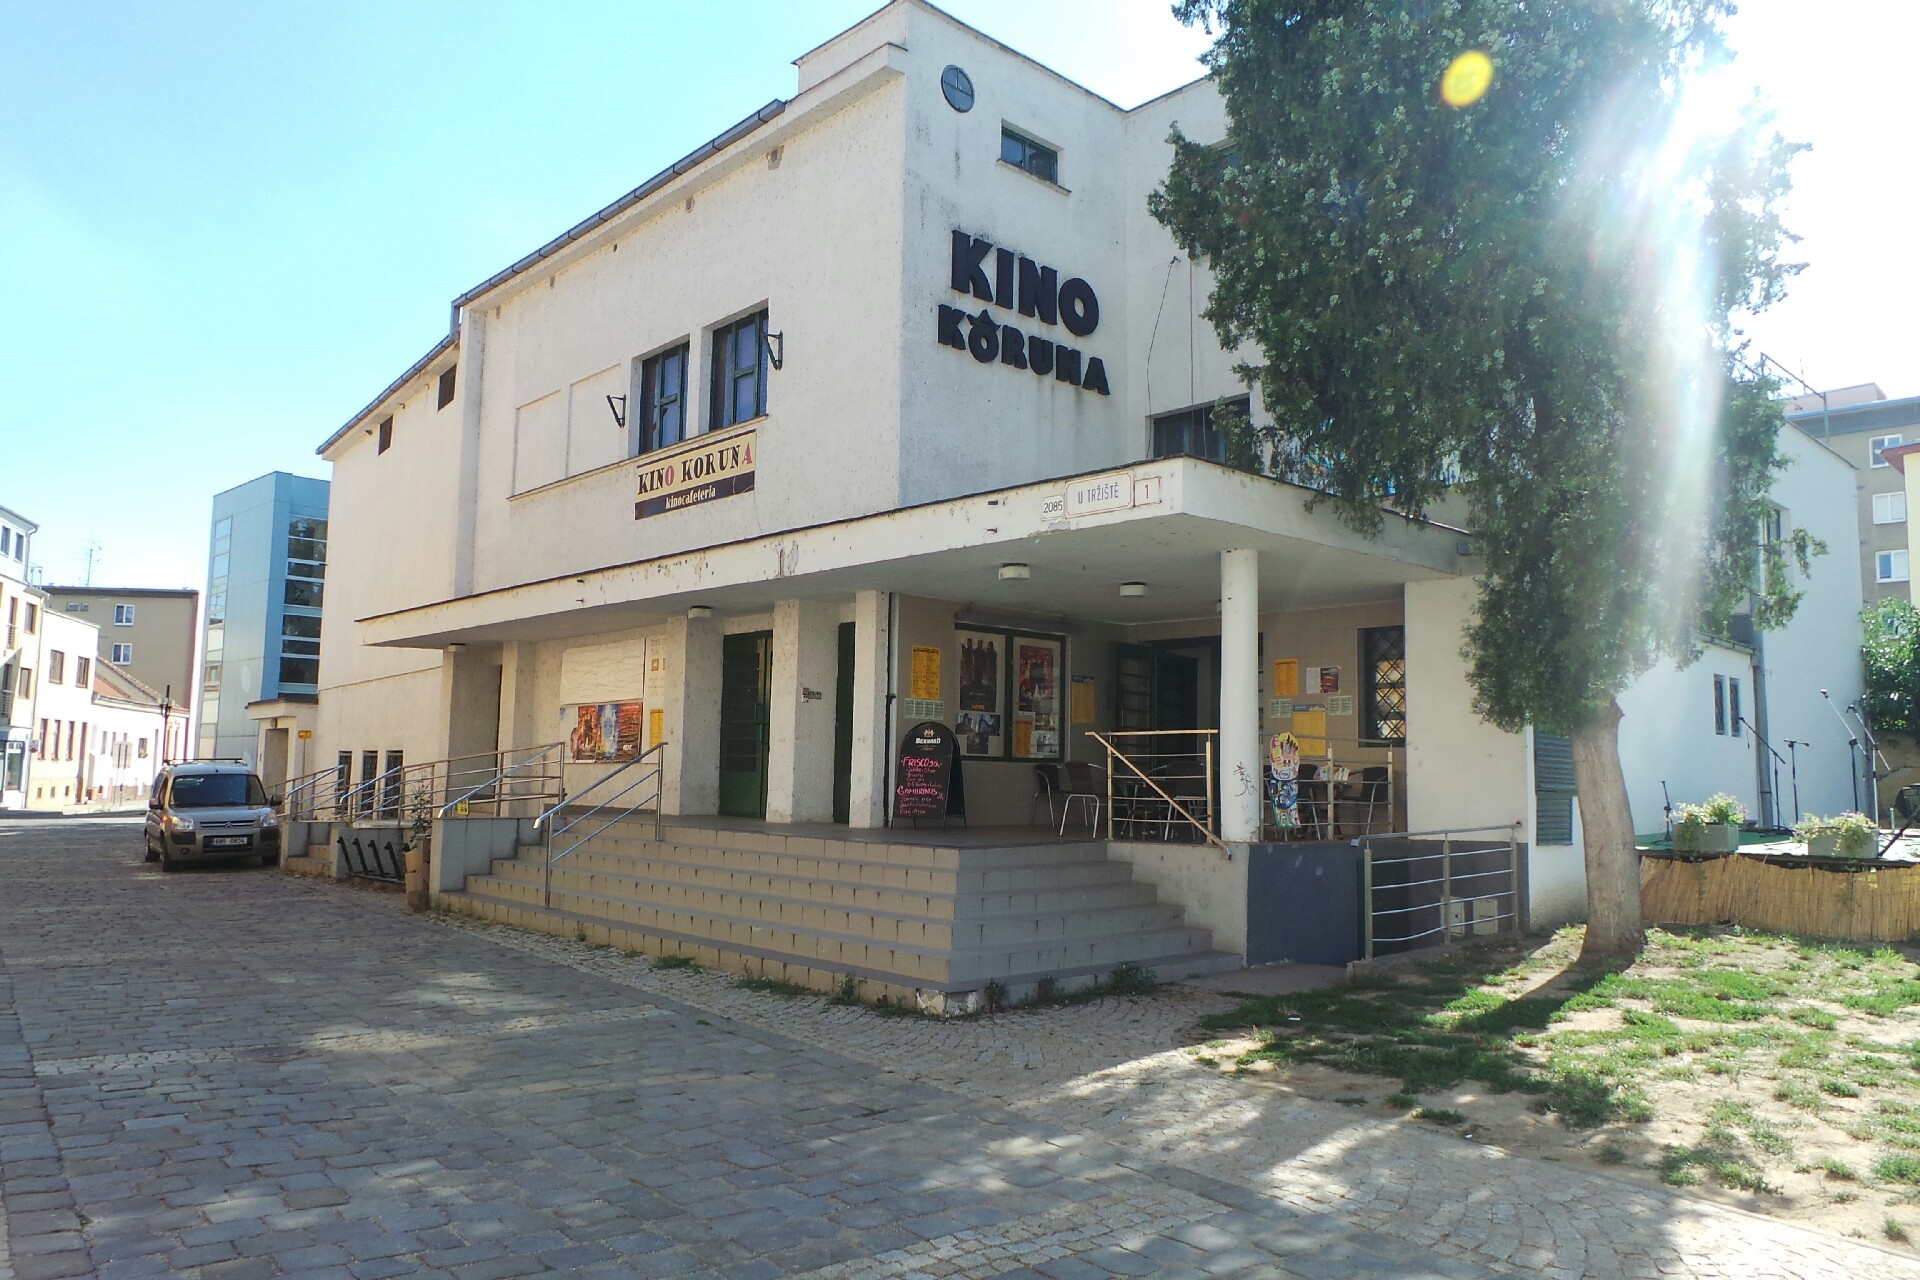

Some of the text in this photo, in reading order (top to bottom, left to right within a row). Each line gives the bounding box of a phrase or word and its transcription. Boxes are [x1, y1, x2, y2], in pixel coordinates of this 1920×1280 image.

[950, 229, 1100, 337] KINO
[937, 304, 1110, 395] KORUNA
[637, 442, 753, 495] KINO KORUNA
[665, 485, 716, 510] kinocafeteria
[1077, 491, 1083, 504] U
[1144, 483, 1149, 499] 1
[1043, 500, 1063, 513] 2085
[902, 756, 930, 767] FRISCO
